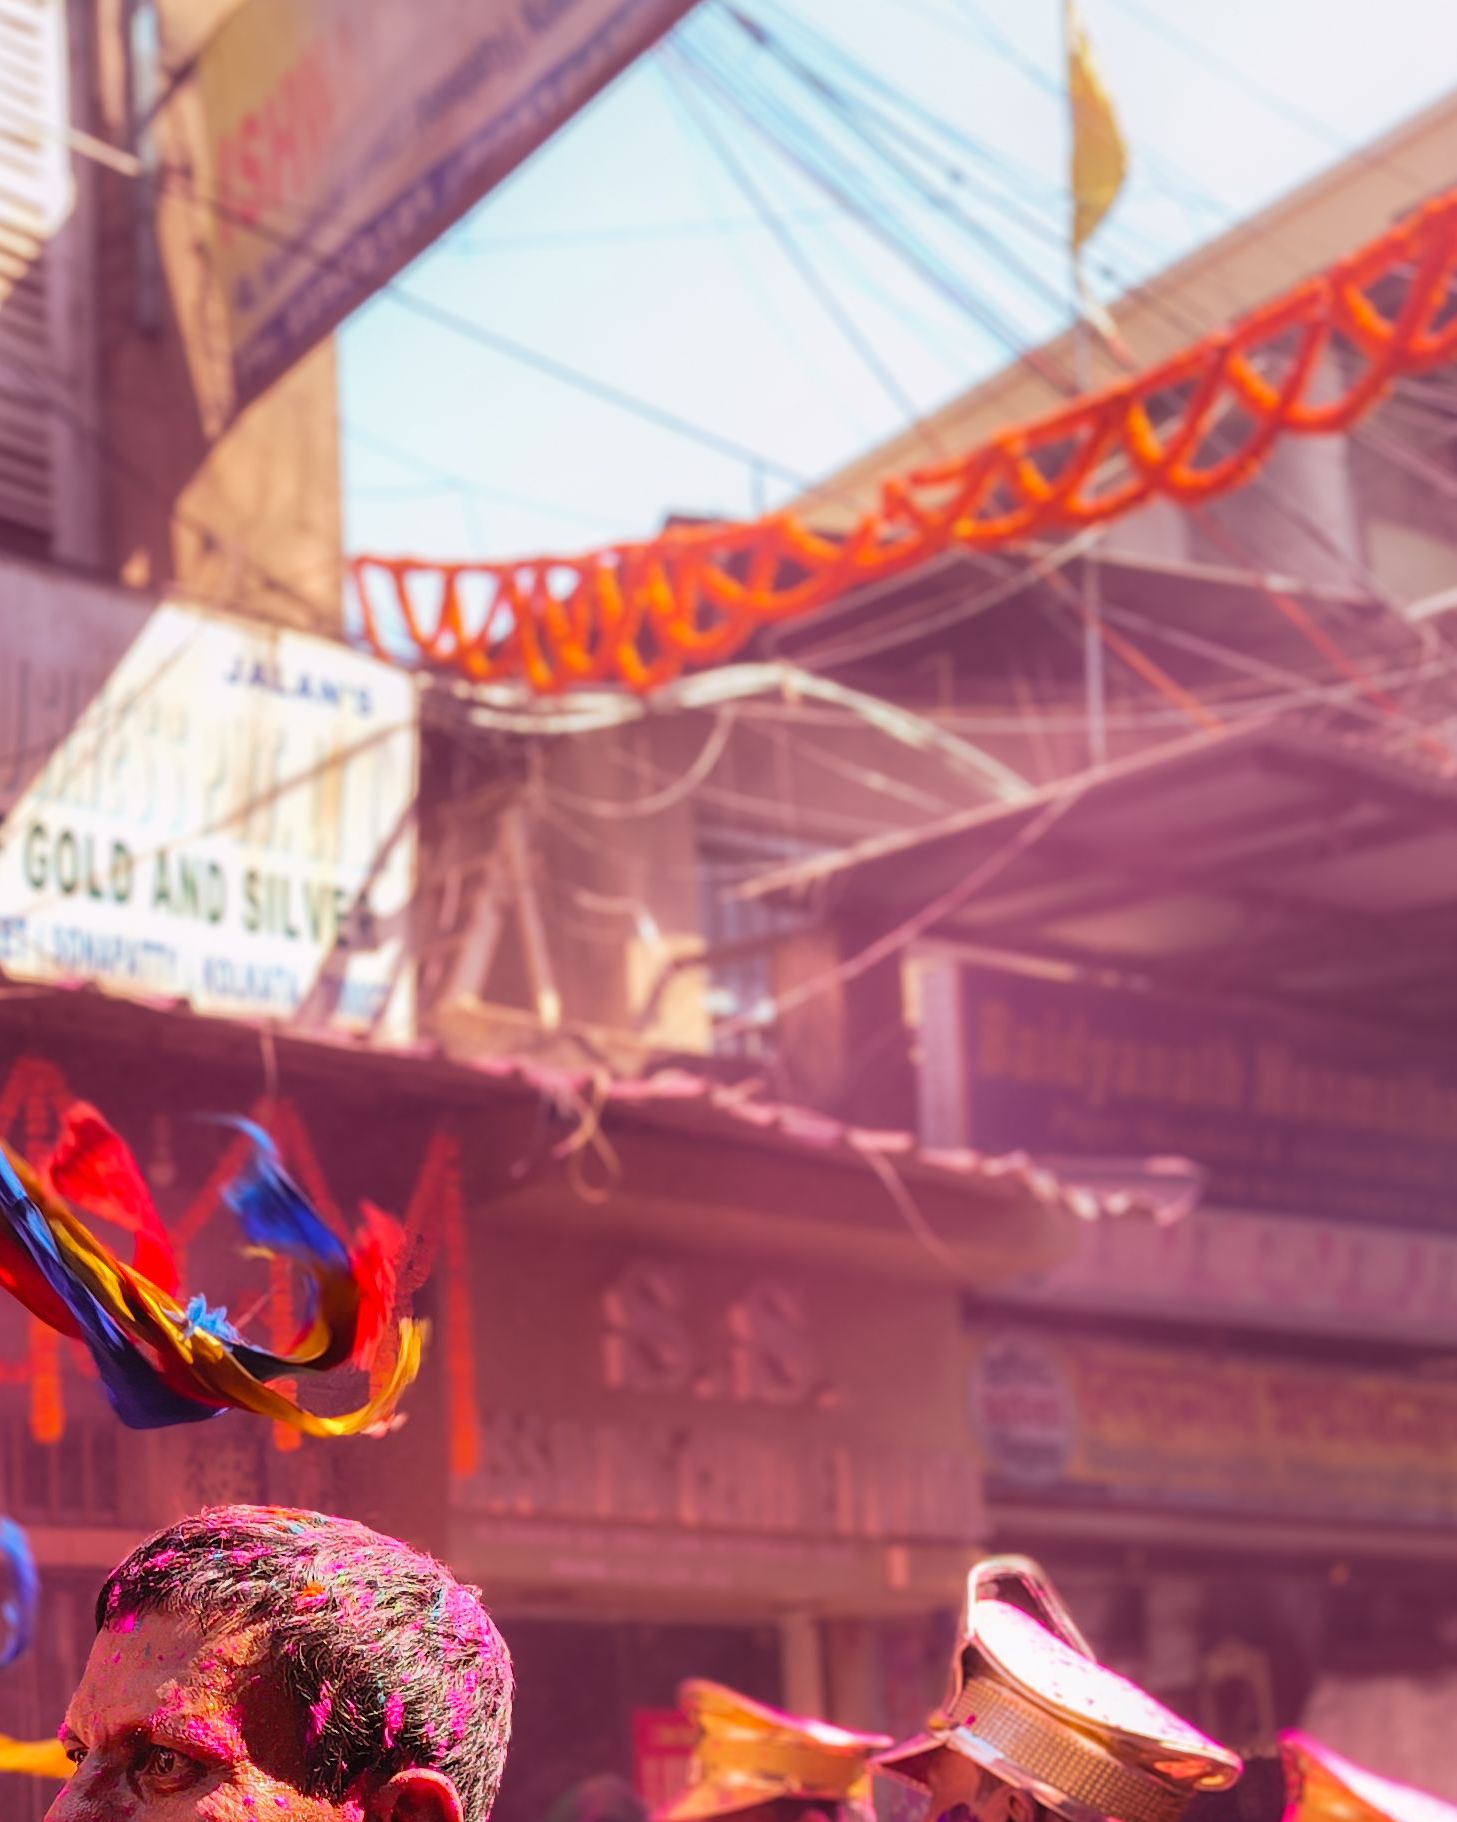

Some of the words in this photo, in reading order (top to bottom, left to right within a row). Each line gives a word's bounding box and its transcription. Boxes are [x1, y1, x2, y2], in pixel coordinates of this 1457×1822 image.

[224, 656, 376, 717] JALAN'S
[22, 823, 135, 906] GOLD
[150, 847, 228, 925] AND
